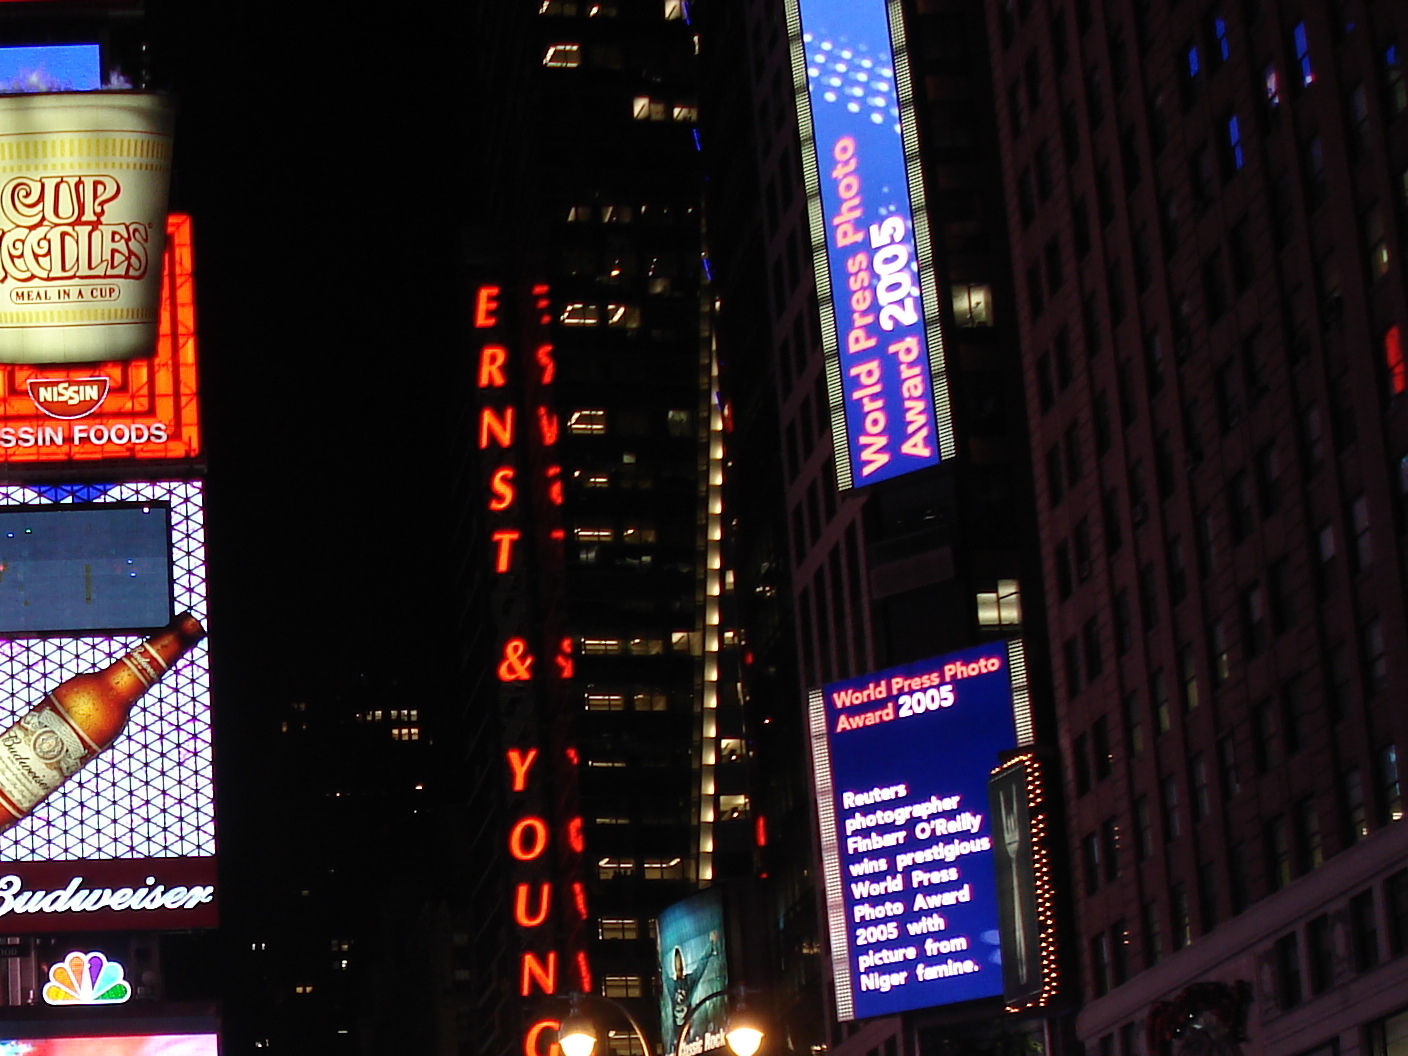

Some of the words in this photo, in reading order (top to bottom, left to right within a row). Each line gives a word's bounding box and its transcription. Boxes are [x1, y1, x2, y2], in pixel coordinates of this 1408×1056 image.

[1, 175, 121, 228] CUP
[833, 136, 864, 248] Photo
[15, 290, 51, 302] MEAL
[57, 289, 70, 300] IN
[77, 289, 85, 300] A
[90, 287, 116, 299] CUP
[869, 216, 918, 331] 2005
[846, 251, 878, 354] Press
[38, 383, 99, 406] NISSIN
[889, 335, 932, 458] Award
[73, 423, 168, 445] FOODS
[850, 358, 890, 477] World
[473, 285, 520, 573] ERNST
[497, 636, 534, 682] &
[833, 680, 887, 709] World
[891, 671, 940, 696] Press
[944, 655, 1000, 682] Photo
[836, 703, 895, 733] Award
[898, 684, 955, 719] 2005
[842, 783, 907, 810] Reuters
[845, 793, 961, 835] photographer
[847, 829, 908, 855] Finbarr
[915, 812, 982, 841] O'Reilly
[849, 856, 888, 877] wins
[896, 835, 991, 871] prestigious
[851, 871, 904, 900] World
[911, 866, 959, 889] Press
[854, 900, 904, 923] Photo
[912, 883, 971, 912] Award
[855, 922, 899, 945] 2005
[906, 913, 945, 936] with
[858, 943, 917, 972] picture
[924, 934, 967, 957] from
[859, 967, 908, 994] Niger
[915, 956, 980, 981] famine.
